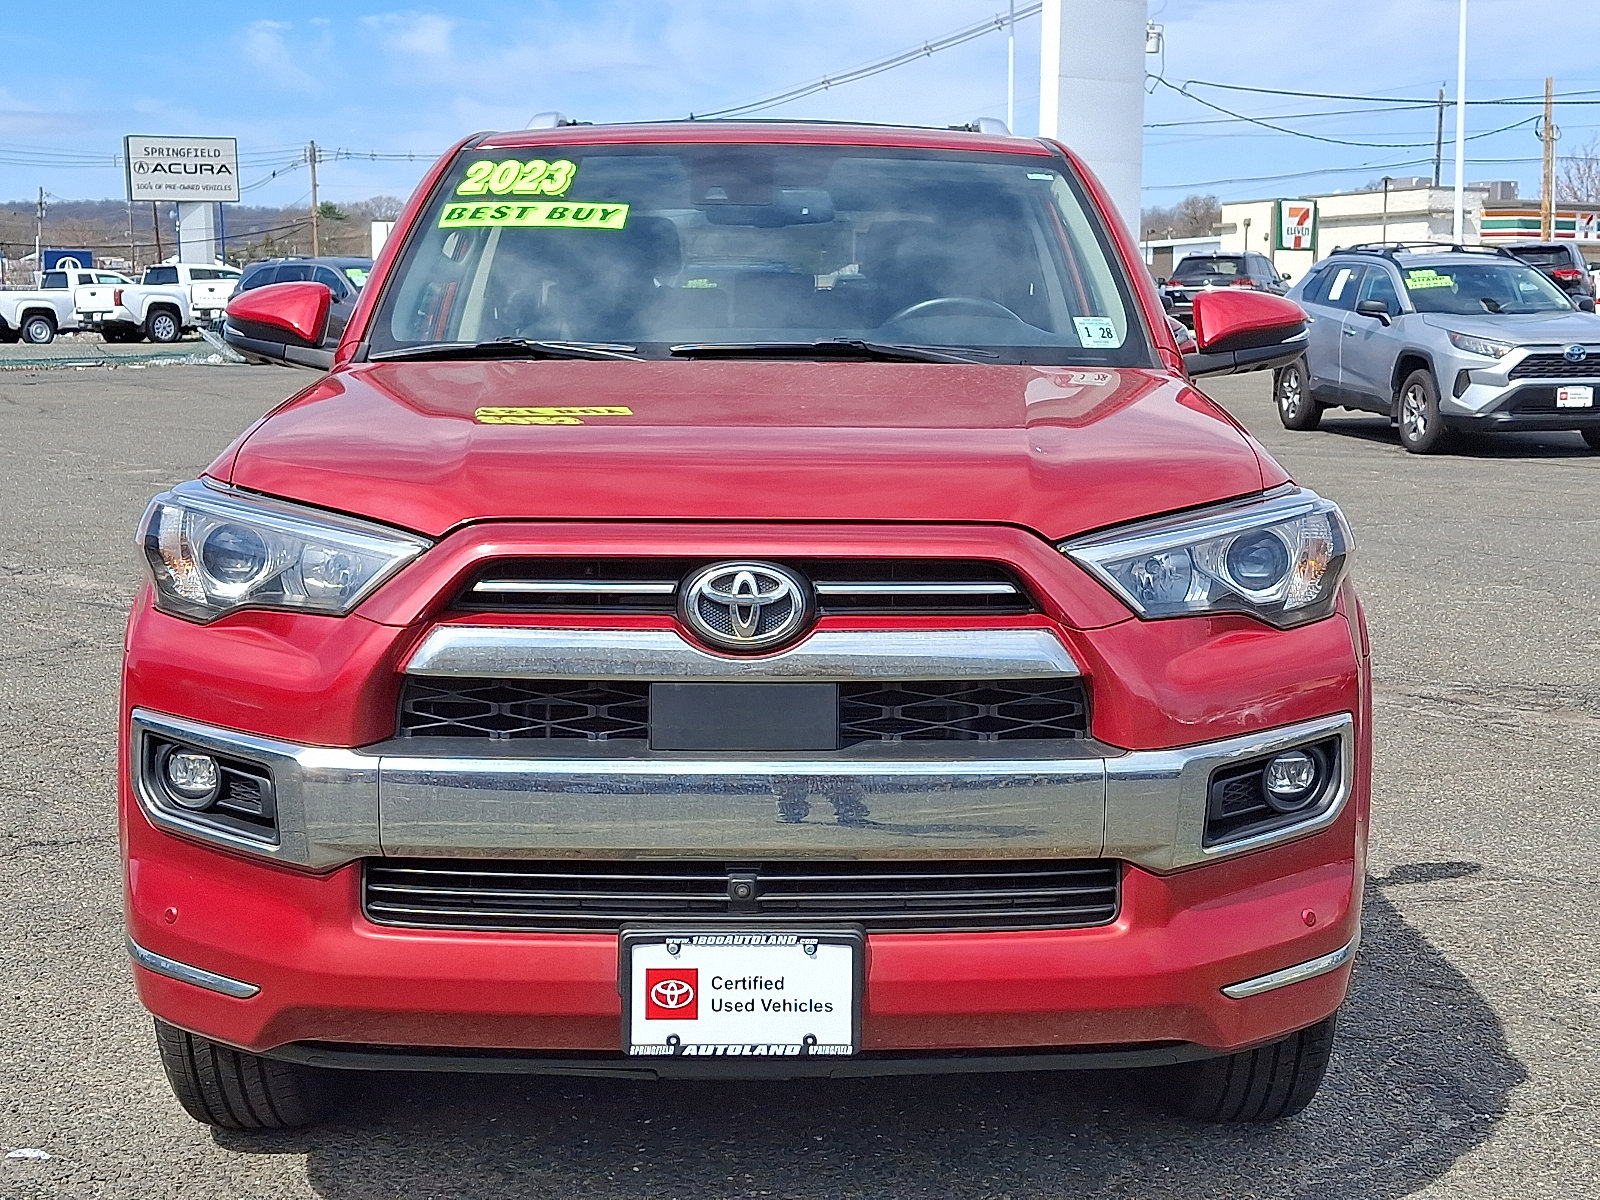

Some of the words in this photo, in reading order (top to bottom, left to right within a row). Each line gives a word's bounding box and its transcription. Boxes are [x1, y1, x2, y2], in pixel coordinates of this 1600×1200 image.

[143, 147, 221, 158] SPRINGFIELD
[151, 163, 232, 175] ACURA
[456, 159, 577, 196] 2023
[445, 206, 536, 221] BEST
[546, 207, 621, 222] BUY
[1288, 207, 1310, 248] 7
[1084, 326, 1093, 337] 1
[1099, 327, 1114, 338] 28
[711, 976, 785, 991] Certified
[711, 999, 755, 1013] Used
[761, 998, 834, 1013] Vehicles
[629, 1045, 674, 1056] SPRINGFIELD
[681, 1044, 802, 1056] AUTOLAND
